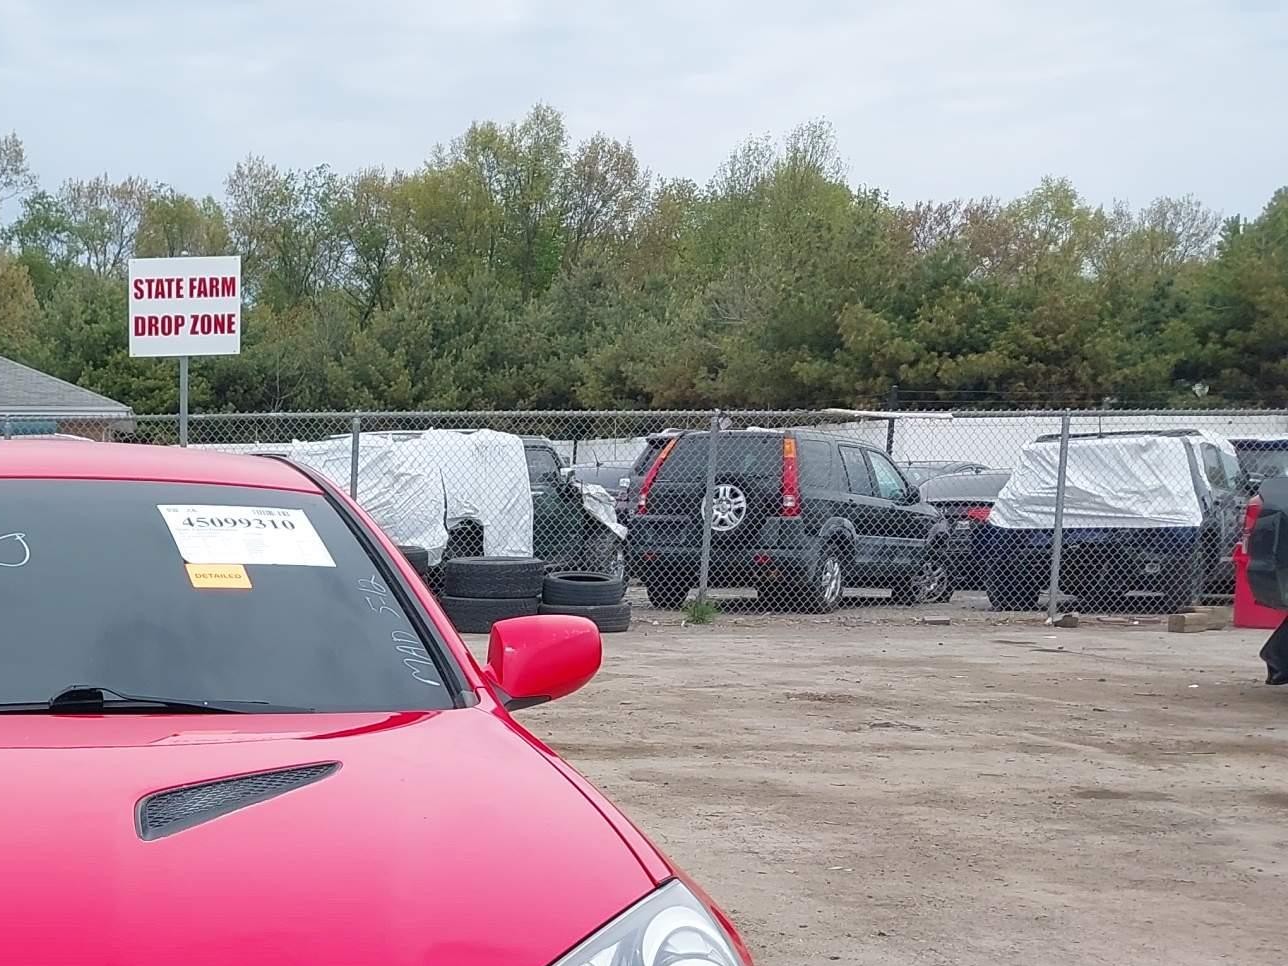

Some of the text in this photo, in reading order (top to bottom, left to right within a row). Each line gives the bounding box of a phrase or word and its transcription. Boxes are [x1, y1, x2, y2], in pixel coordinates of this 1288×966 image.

[134, 276, 236, 299] STATE FARM
[134, 314, 236, 336] DROP ZONE
[182, 516, 296, 531] 45099310
[194, 572, 242, 580] DETAILED
